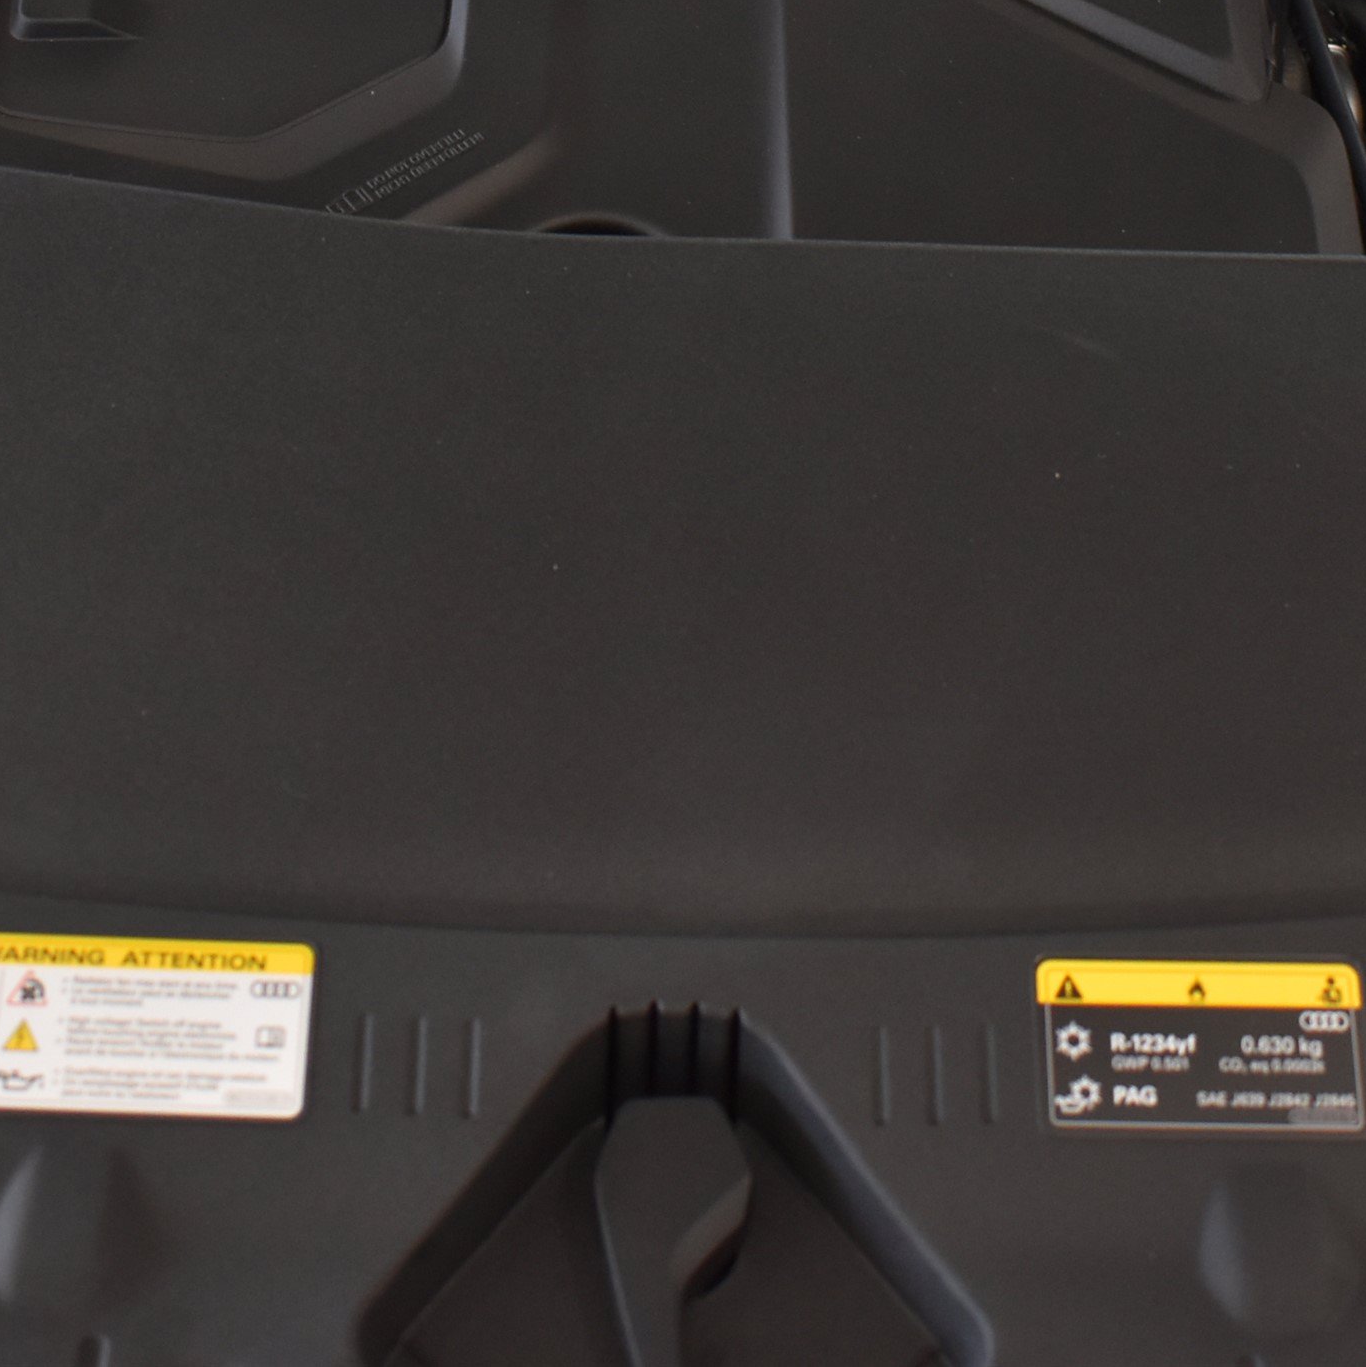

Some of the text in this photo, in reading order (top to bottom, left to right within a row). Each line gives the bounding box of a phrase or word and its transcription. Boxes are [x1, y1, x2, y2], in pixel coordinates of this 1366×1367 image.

[121, 947, 268, 970] ATTENTION
[1110, 1032, 1196, 1056] R-1234yf
[1298, 1035, 1323, 1060] kg
[1113, 1084, 1158, 1107] PAG
[1196, 1090, 1227, 1107] SAE
